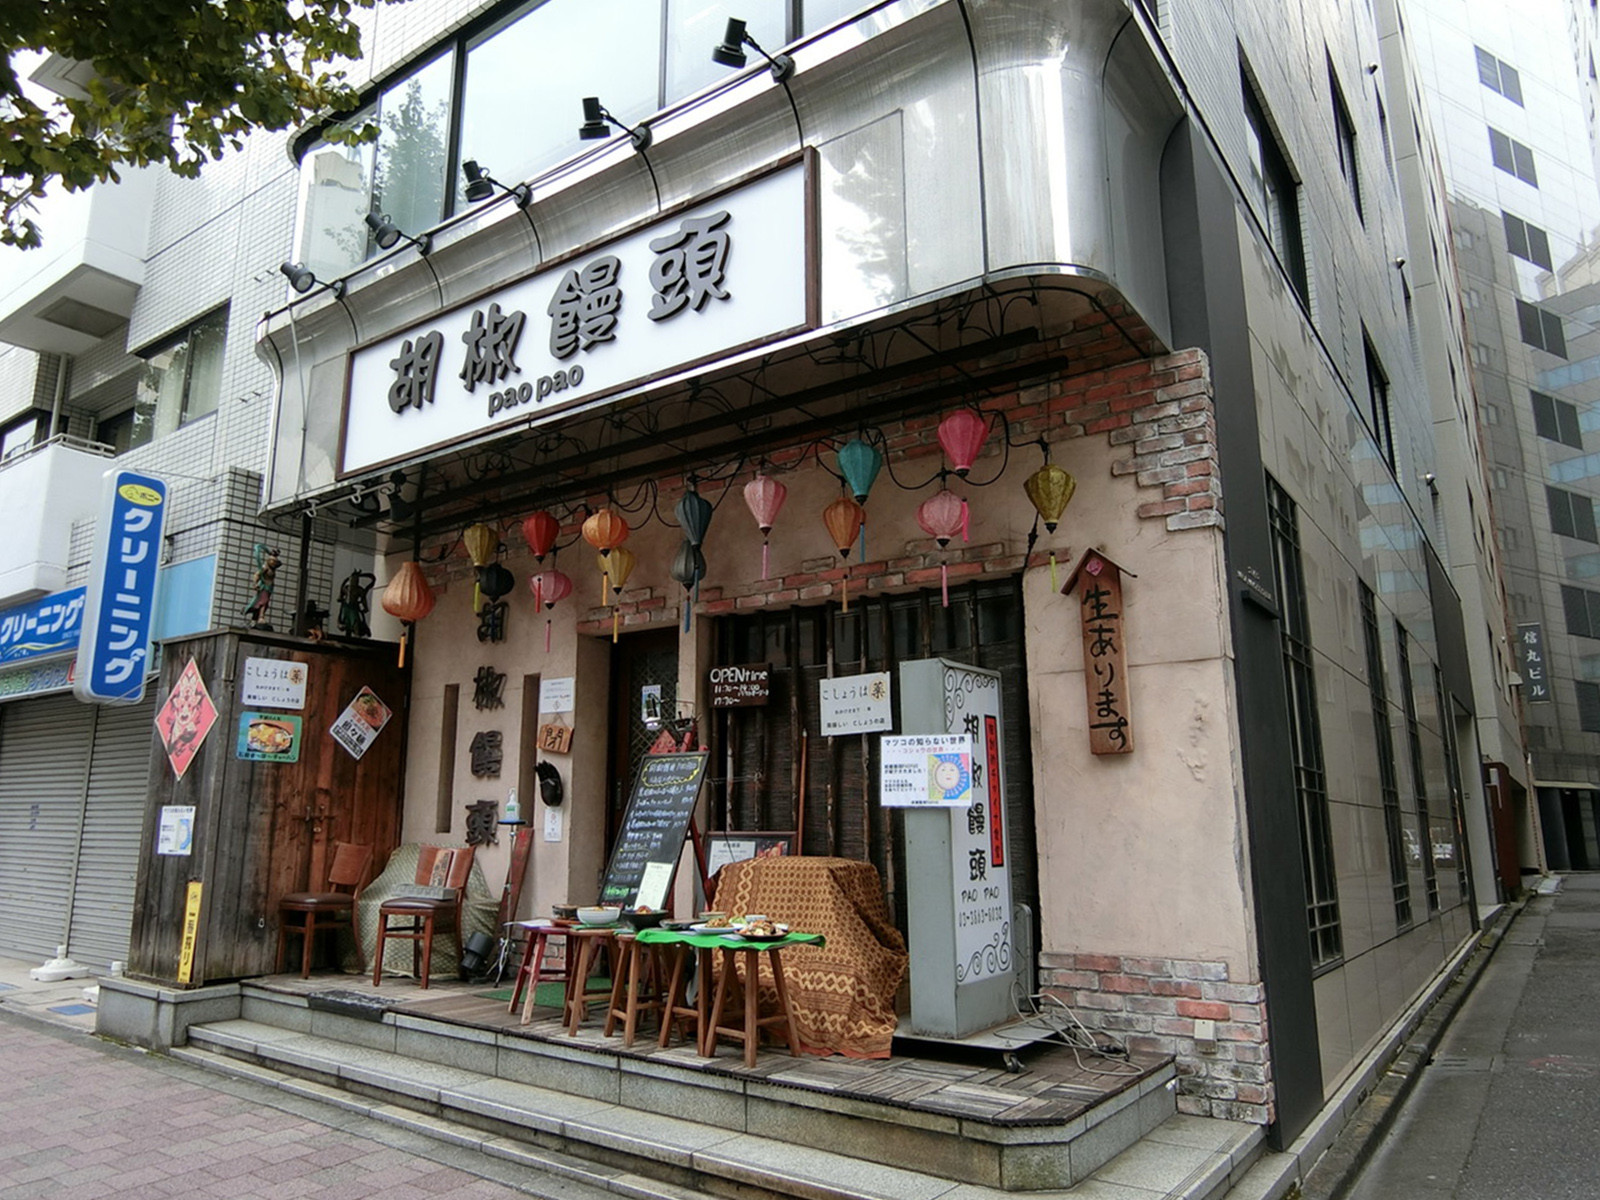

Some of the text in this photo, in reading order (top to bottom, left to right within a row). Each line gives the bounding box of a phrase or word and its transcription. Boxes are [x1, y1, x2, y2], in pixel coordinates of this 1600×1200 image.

[388, 210, 732, 414] 胡椒饅頭
[487, 364, 584, 417] pao pao
[0, 594, 85, 645] クリーニング
[104, 507, 153, 685] クリーニング
[1083, 584, 1129, 750] 生あります
[1524, 631, 1545, 697] 信丸ビル
[822, 681, 886, 701] こしょうは薬
[884, 736, 965, 746] マツコの知らない世界
[961, 886, 1000, 903] PAO PAO
